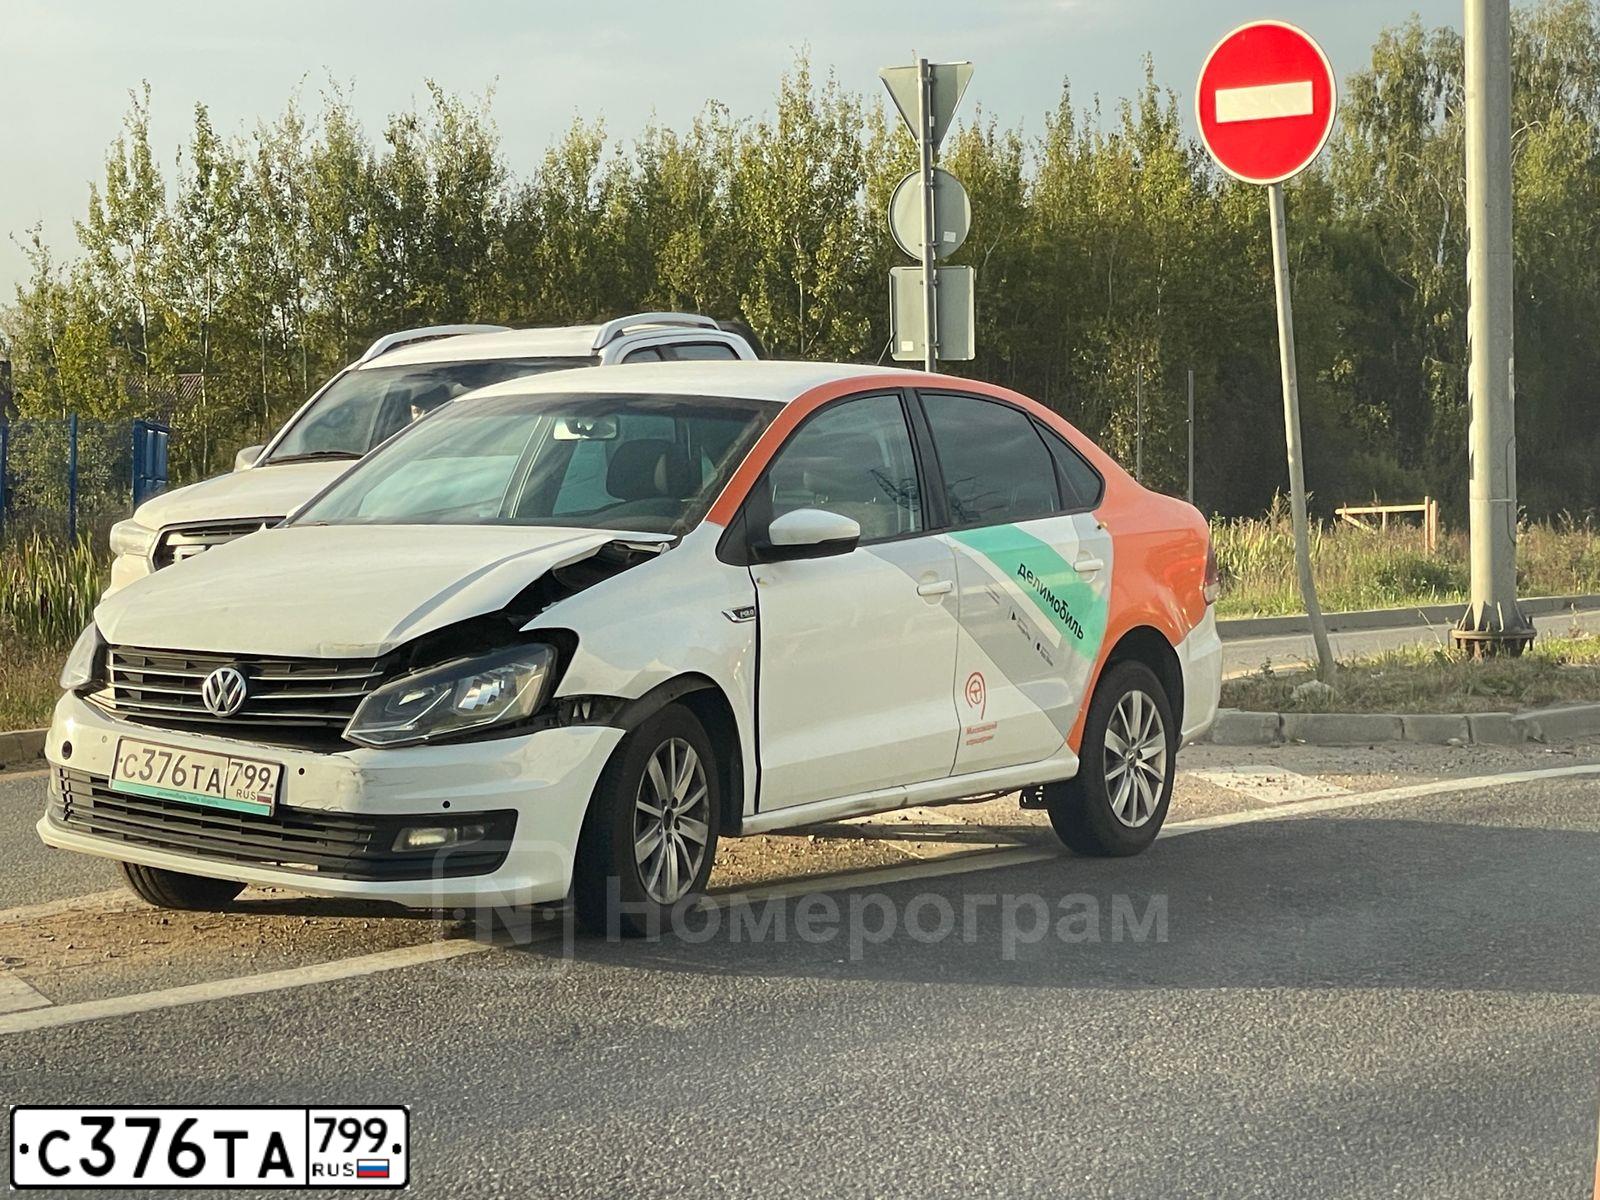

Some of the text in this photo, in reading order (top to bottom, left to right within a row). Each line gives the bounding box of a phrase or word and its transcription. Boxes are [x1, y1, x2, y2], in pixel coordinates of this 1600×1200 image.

[1017, 563, 1084, 640] делимобиль
[230, 761, 271, 792] 799
[236, 789, 256, 800] RUS
